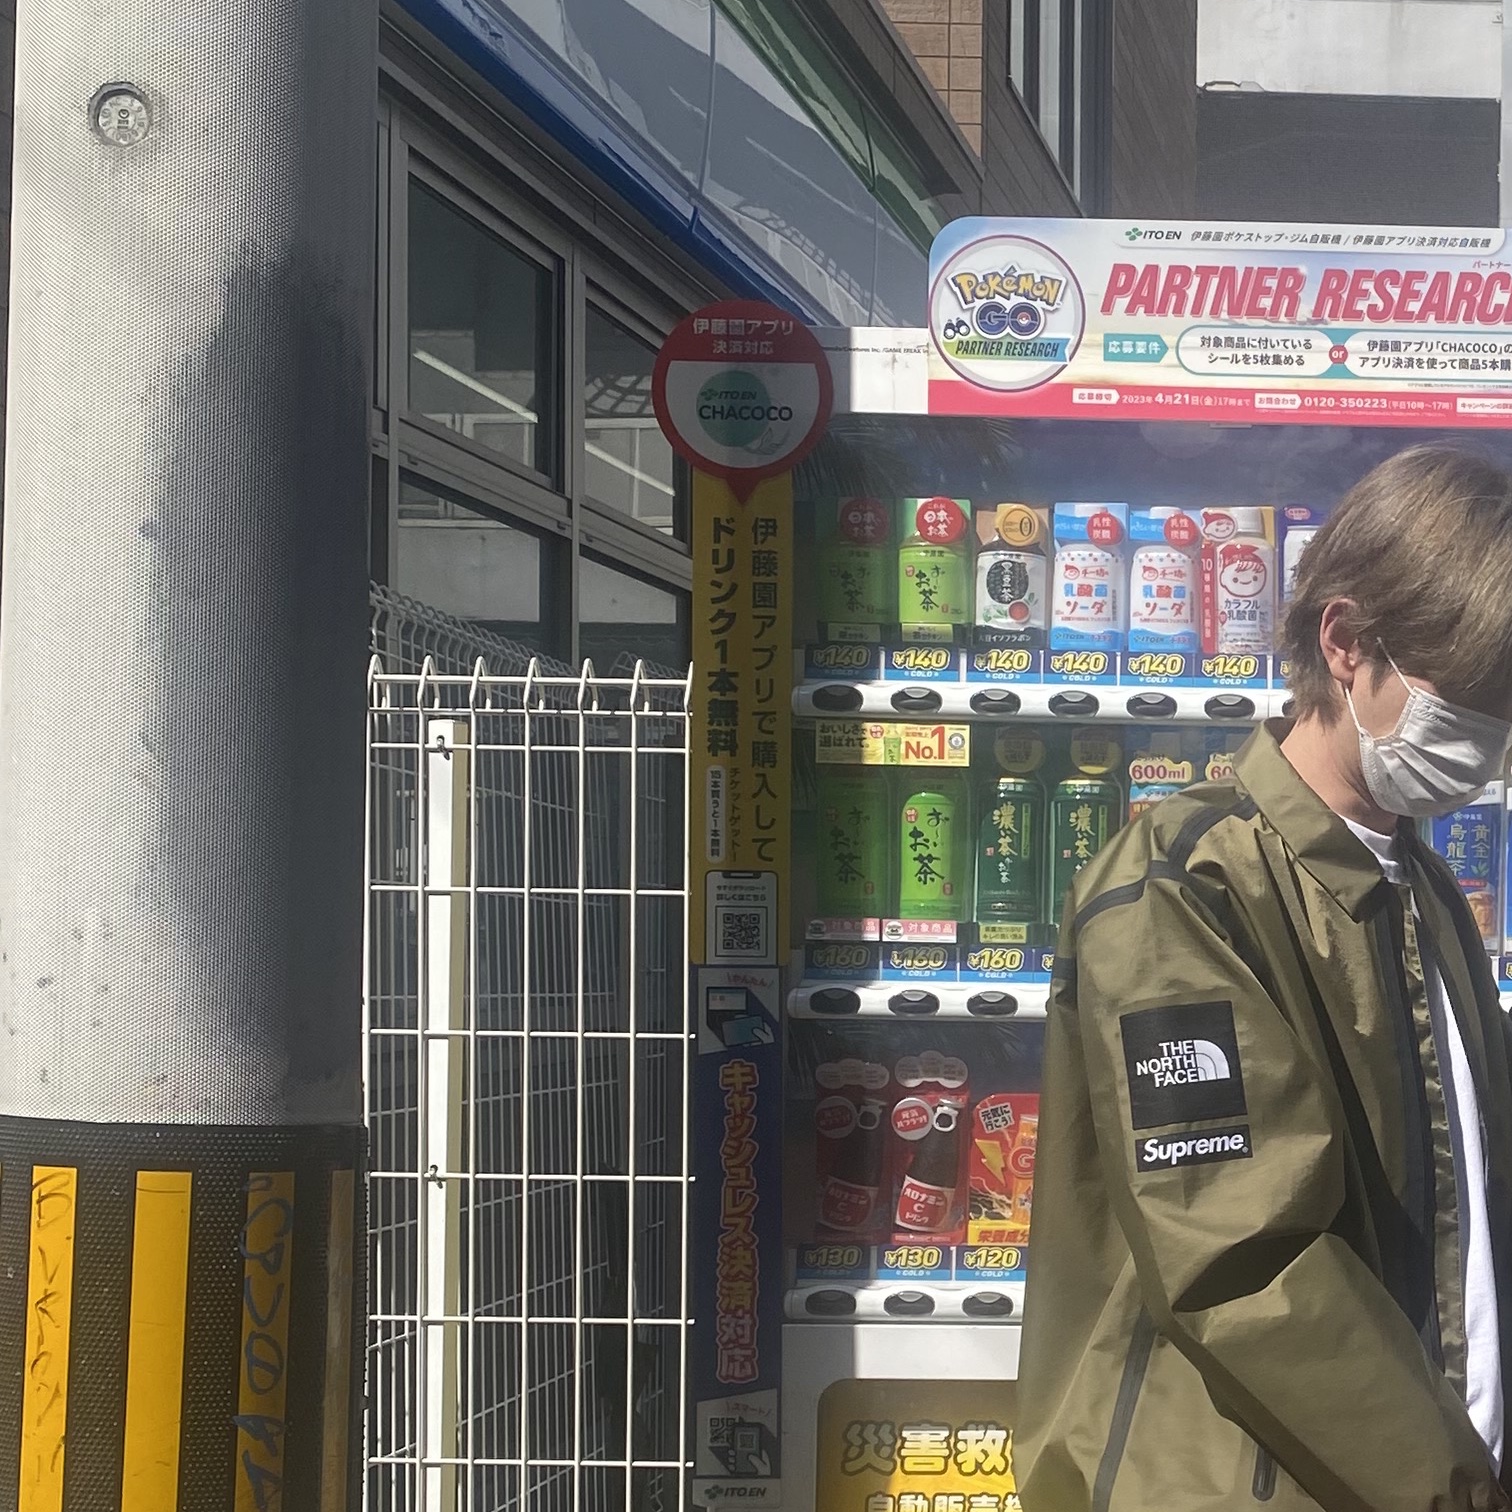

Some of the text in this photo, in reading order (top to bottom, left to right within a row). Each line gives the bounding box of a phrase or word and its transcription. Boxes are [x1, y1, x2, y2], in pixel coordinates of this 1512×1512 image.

[1352, 234, 1492, 248] 伊藤園アプリ決済対応自販機
[1100, 263, 1306, 319] PARTNER
[693, 318, 794, 335] 伊藤園アプリ
[975, 301, 1046, 336] GO
[713, 340, 773, 355] 決済対応
[956, 340, 1059, 358] PARTNER RESEARCH
[1200, 336, 1313, 350] 対象商品に付いている
[1207, 353, 1305, 367] シールを5枚集める
[1332, 349, 1345, 360] or
[718, 390, 757, 400] ITO EN
[700, 404, 793, 422] CHACOCO
[707, 516, 739, 757] ドリンク1本無料
[974, 649, 1031, 671] ¥140
[1128, 653, 1185, 677] ¥140
[751, 516, 778, 862] 伊藤園アプリで購入して
[1131, 765, 1185, 780] 600ml
[908, 826, 945, 885] お茶
[891, 947, 948, 971] ¥160
[1158, 1040, 1193, 1056] THE
[1135, 1053, 1197, 1076] NORTH
[1154, 1067, 1199, 1088] FACE
[1143, 1133, 1244, 1165] Supreme
[717, 1059, 760, 1384] キャッシュレス決済対応
[963, 1247, 1021, 1270] ¥120
[841, 1419, 1014, 1476] 災害救
[724, 1487, 767, 1497] ITO EN
